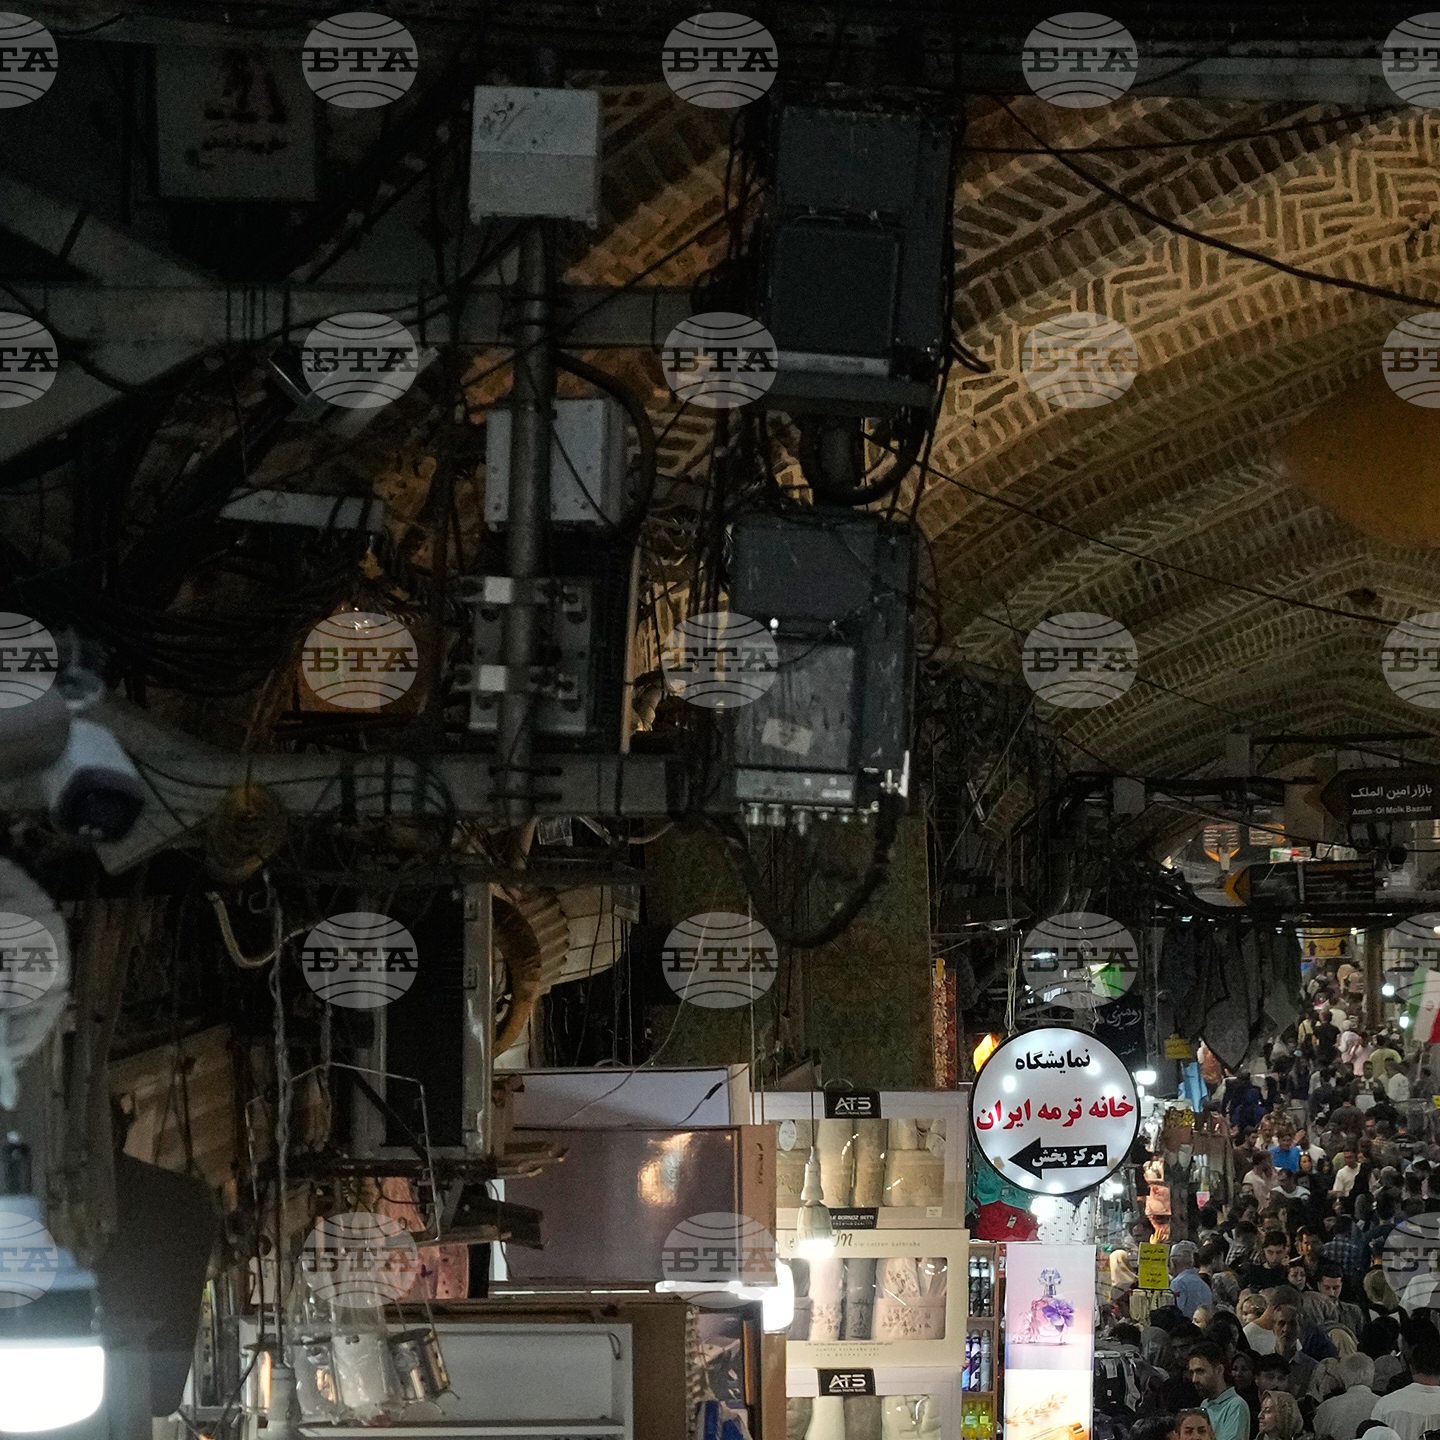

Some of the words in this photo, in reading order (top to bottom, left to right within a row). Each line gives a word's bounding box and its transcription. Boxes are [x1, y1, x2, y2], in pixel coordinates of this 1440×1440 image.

[1350, 786, 1384, 799] الملک
[1386, 785, 1411, 800] امین
[1412, 784, 1433, 799] بازار
[1015, 1049, 1091, 1074] نمایشگاه
[835, 1096, 872, 1111] ATS
[1037, 1097, 1083, 1128] ترمه
[1088, 1094, 1135, 1119] خانه
[975, 1098, 1032, 1130] ایران
[1031, 1148, 1069, 1168] پخش
[1070, 1147, 1105, 1165] مرکز
[828, 1374, 866, 1388] ATS
